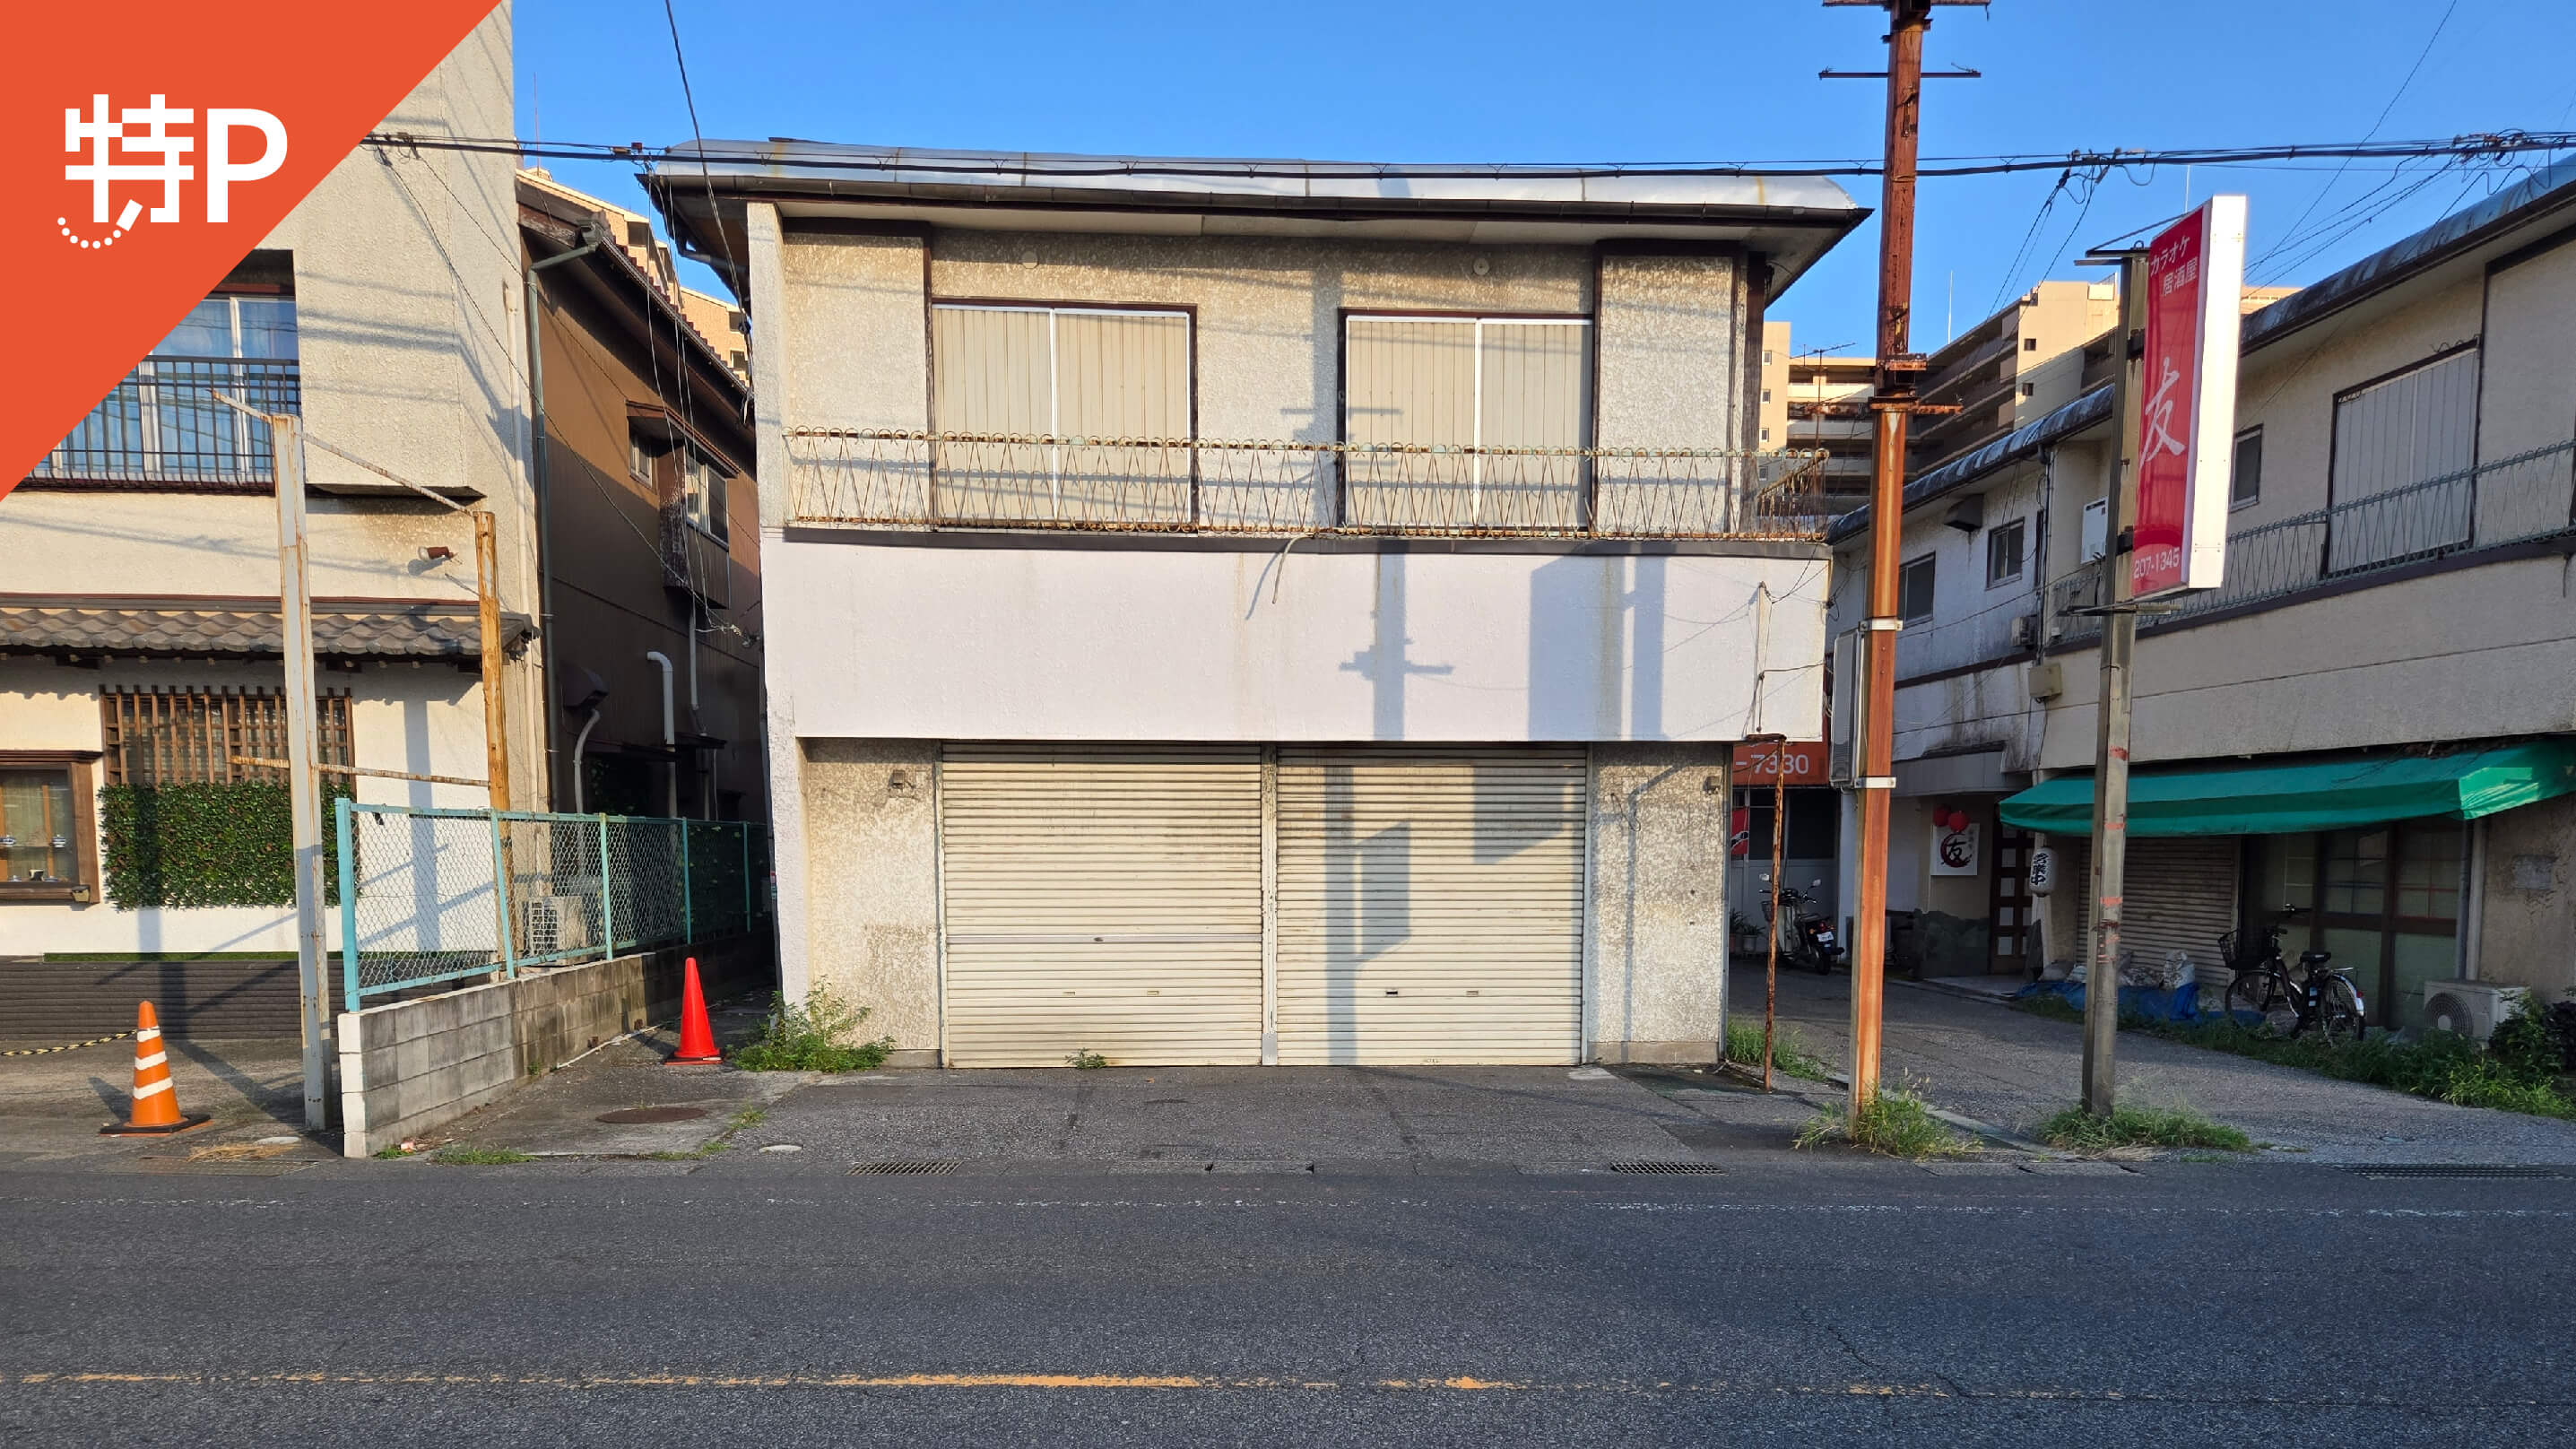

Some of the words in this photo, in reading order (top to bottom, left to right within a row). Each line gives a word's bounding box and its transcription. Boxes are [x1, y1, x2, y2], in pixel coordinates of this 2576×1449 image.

[2150, 235, 2190, 277] カラオケ
[2163, 256, 2199, 297] 居酒屋
[2138, 357, 2186, 471] 友
[2134, 547, 2181, 579] 207-1345
